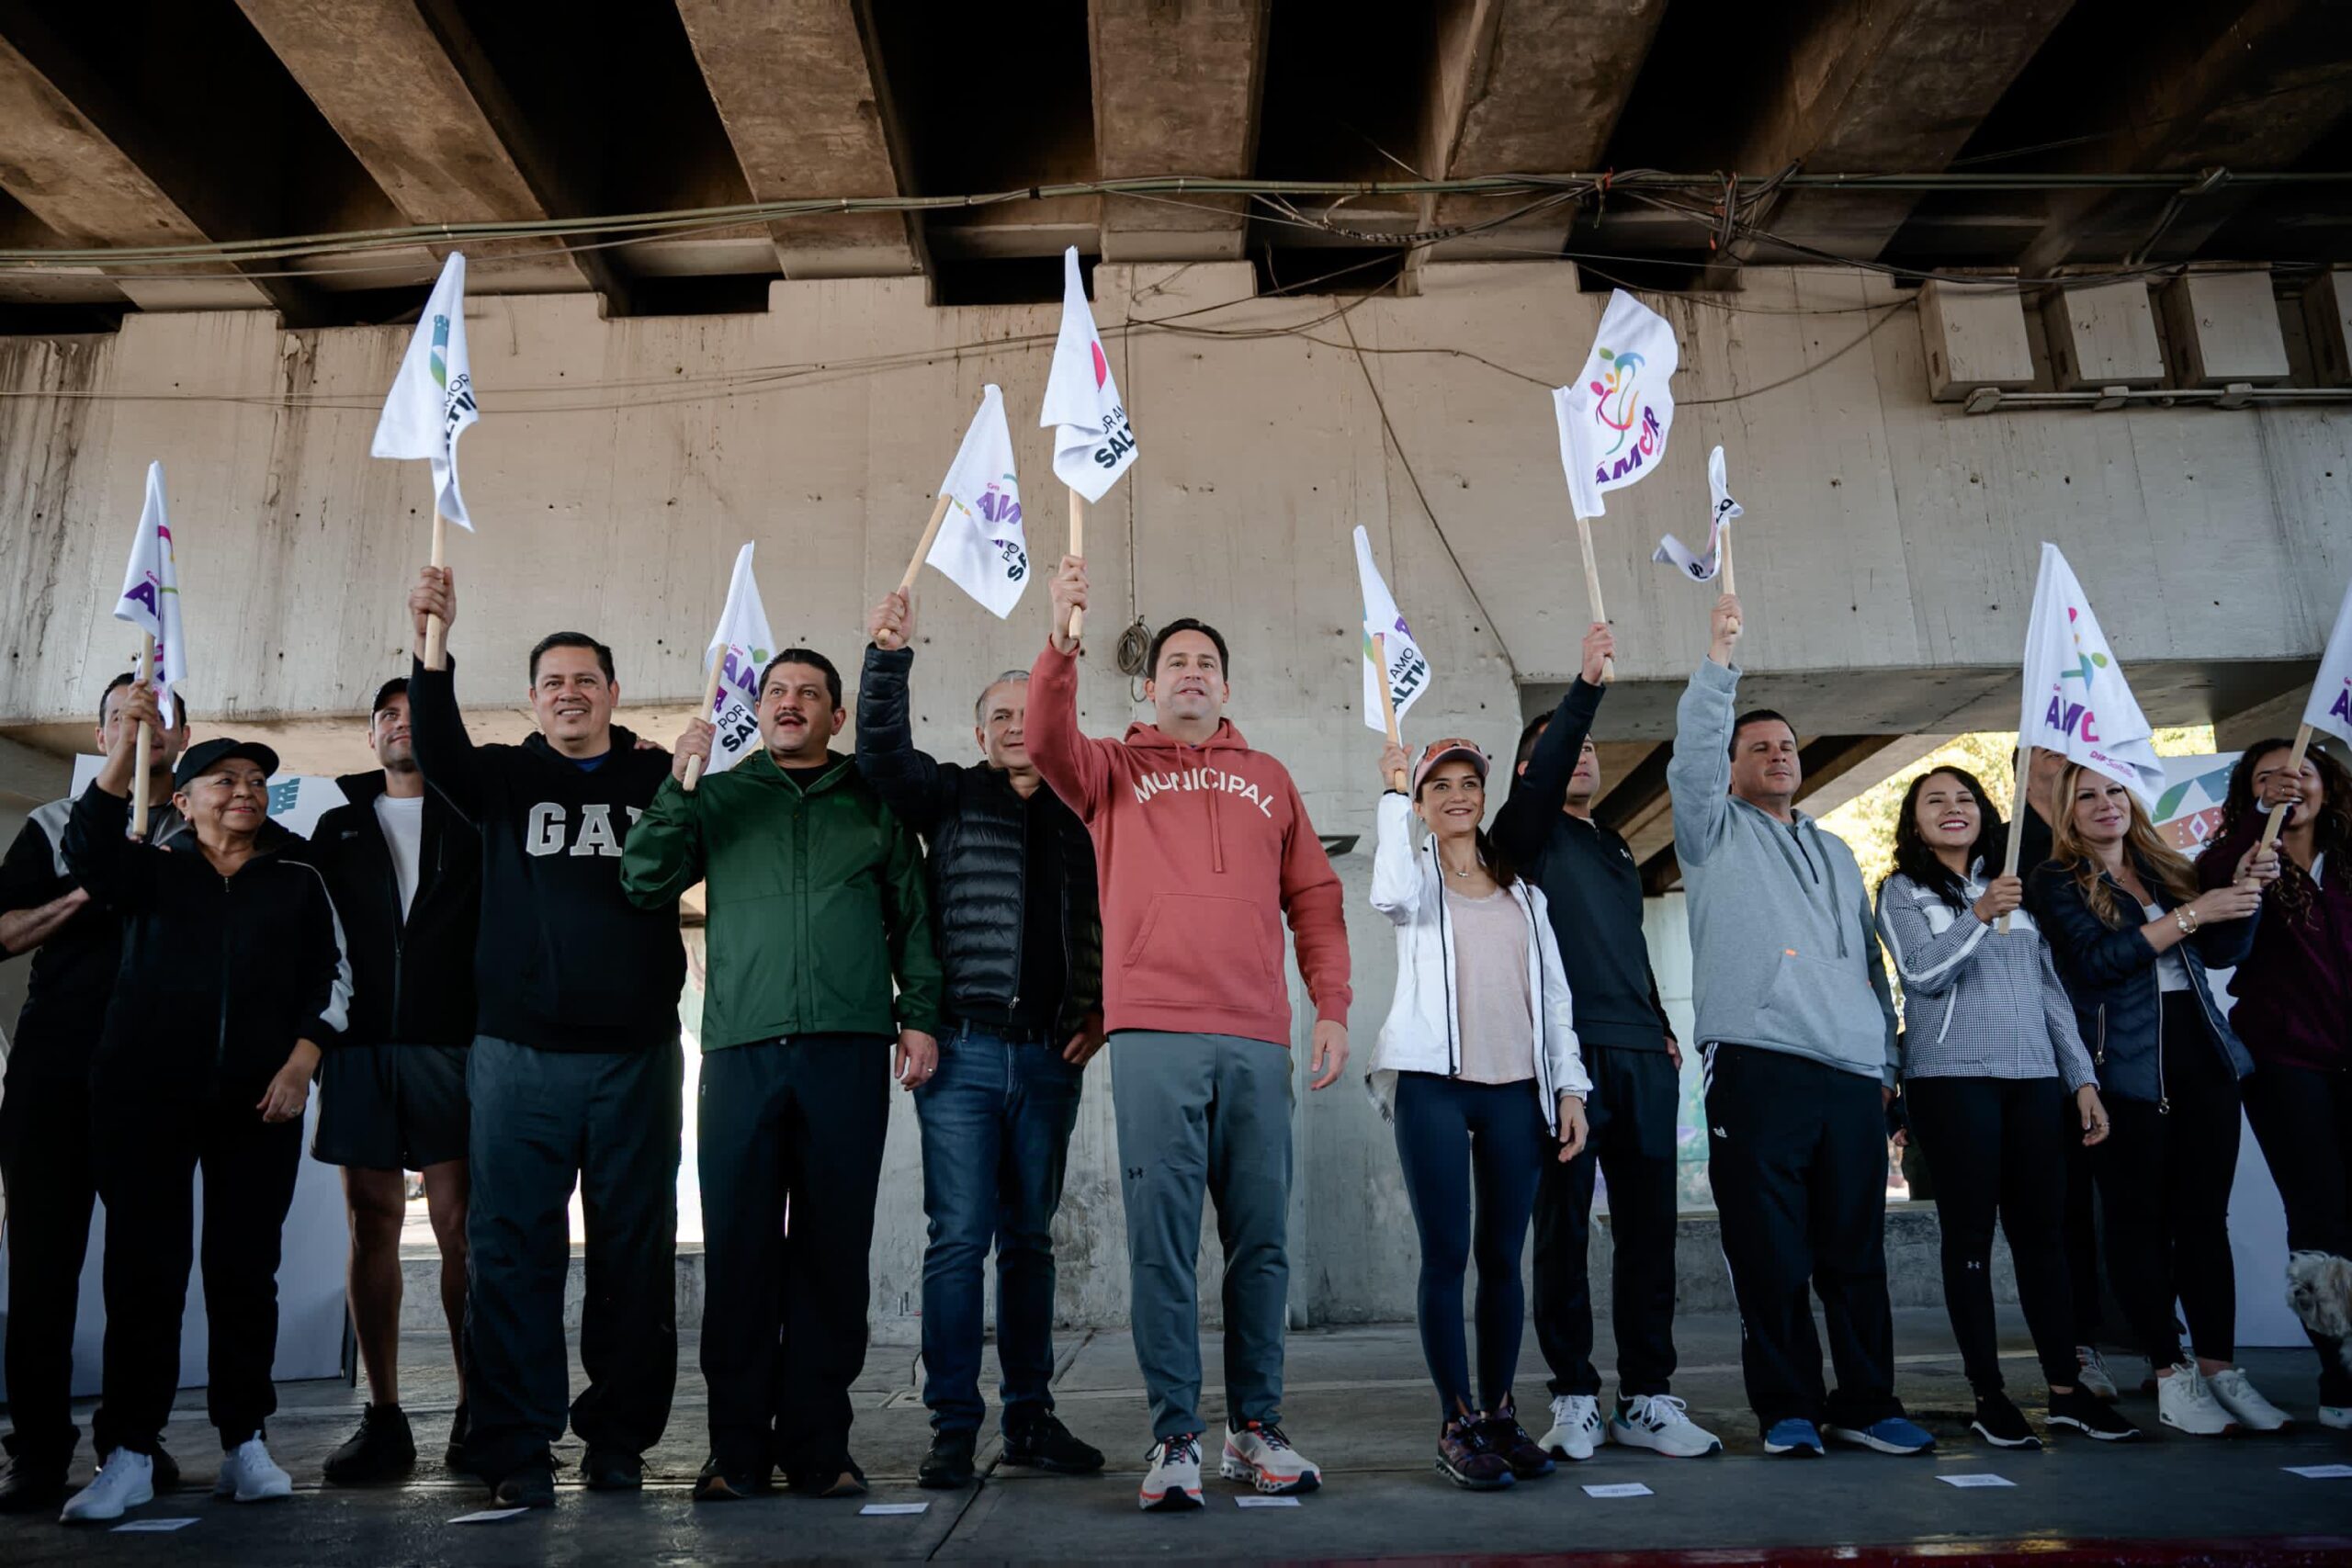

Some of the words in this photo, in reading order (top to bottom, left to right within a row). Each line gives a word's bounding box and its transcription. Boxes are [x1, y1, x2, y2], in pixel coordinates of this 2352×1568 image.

[1596, 405, 1660, 485] AMOR
[718, 704, 746, 730] POR
[1132, 766, 1274, 818] MUNICIPAL
